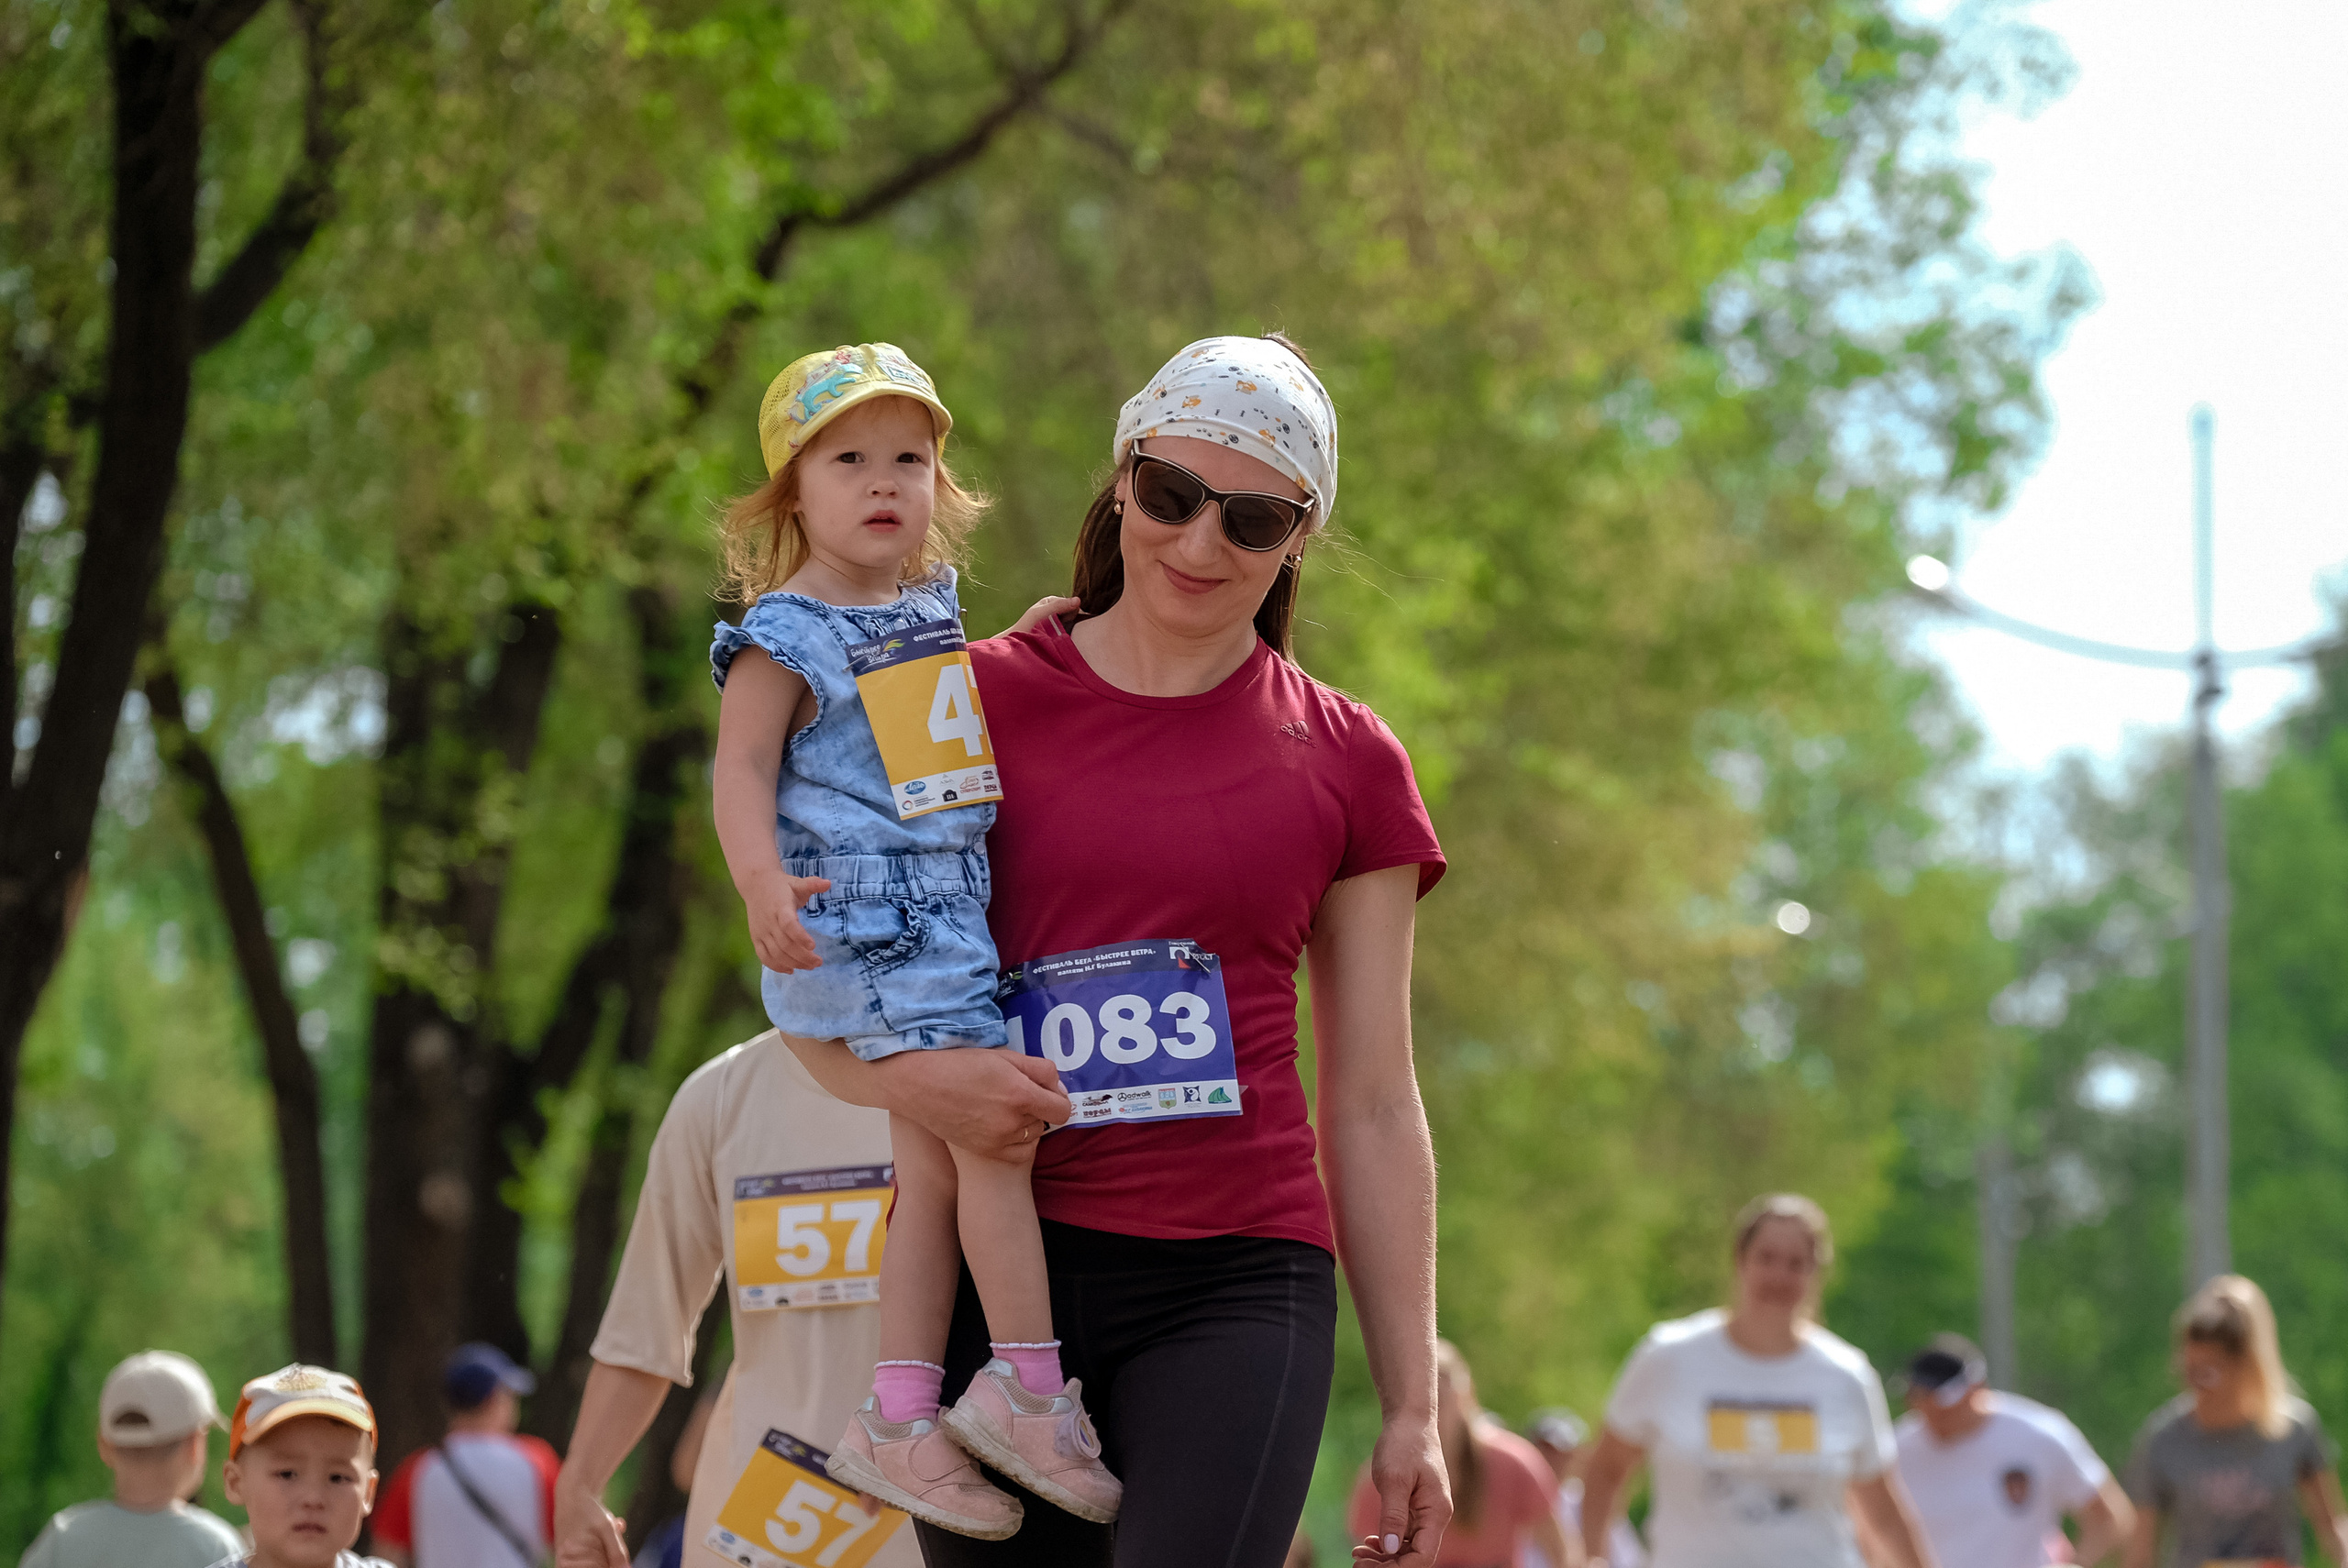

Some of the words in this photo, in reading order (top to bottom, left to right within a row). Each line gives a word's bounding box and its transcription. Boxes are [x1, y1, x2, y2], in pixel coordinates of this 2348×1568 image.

[927, 664, 993, 756] 4
[1279, 725, 1317, 748] adidas
[1033, 960, 1073, 974] ФЕСТИВАЛЬ
[1075, 957, 1092, 966] БЕГА
[775, 1199, 881, 1276] 57
[765, 1479, 880, 1567] 57
